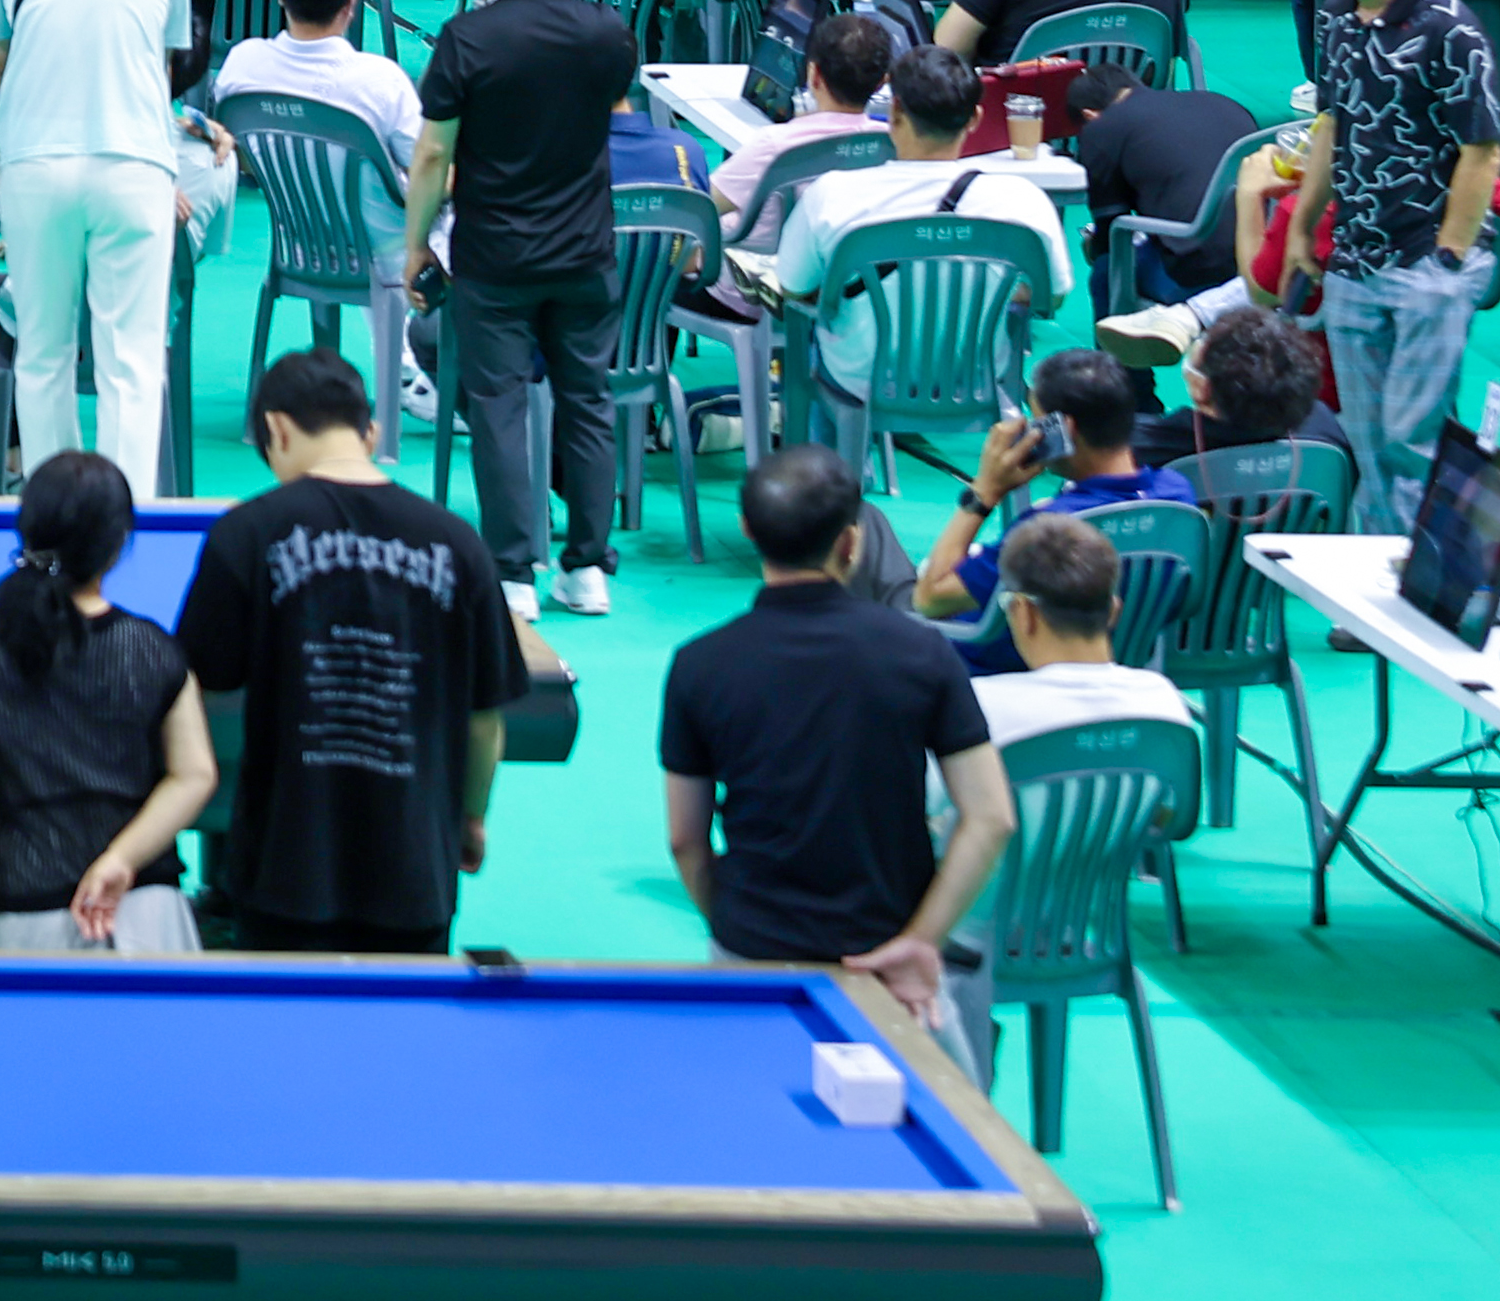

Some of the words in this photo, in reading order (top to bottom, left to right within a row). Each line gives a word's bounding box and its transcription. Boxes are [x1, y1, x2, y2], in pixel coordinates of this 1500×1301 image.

[1085, 15, 1127, 29] 의신면
[259, 100, 305, 118] 의신면
[914, 225, 971, 242] 의신면
